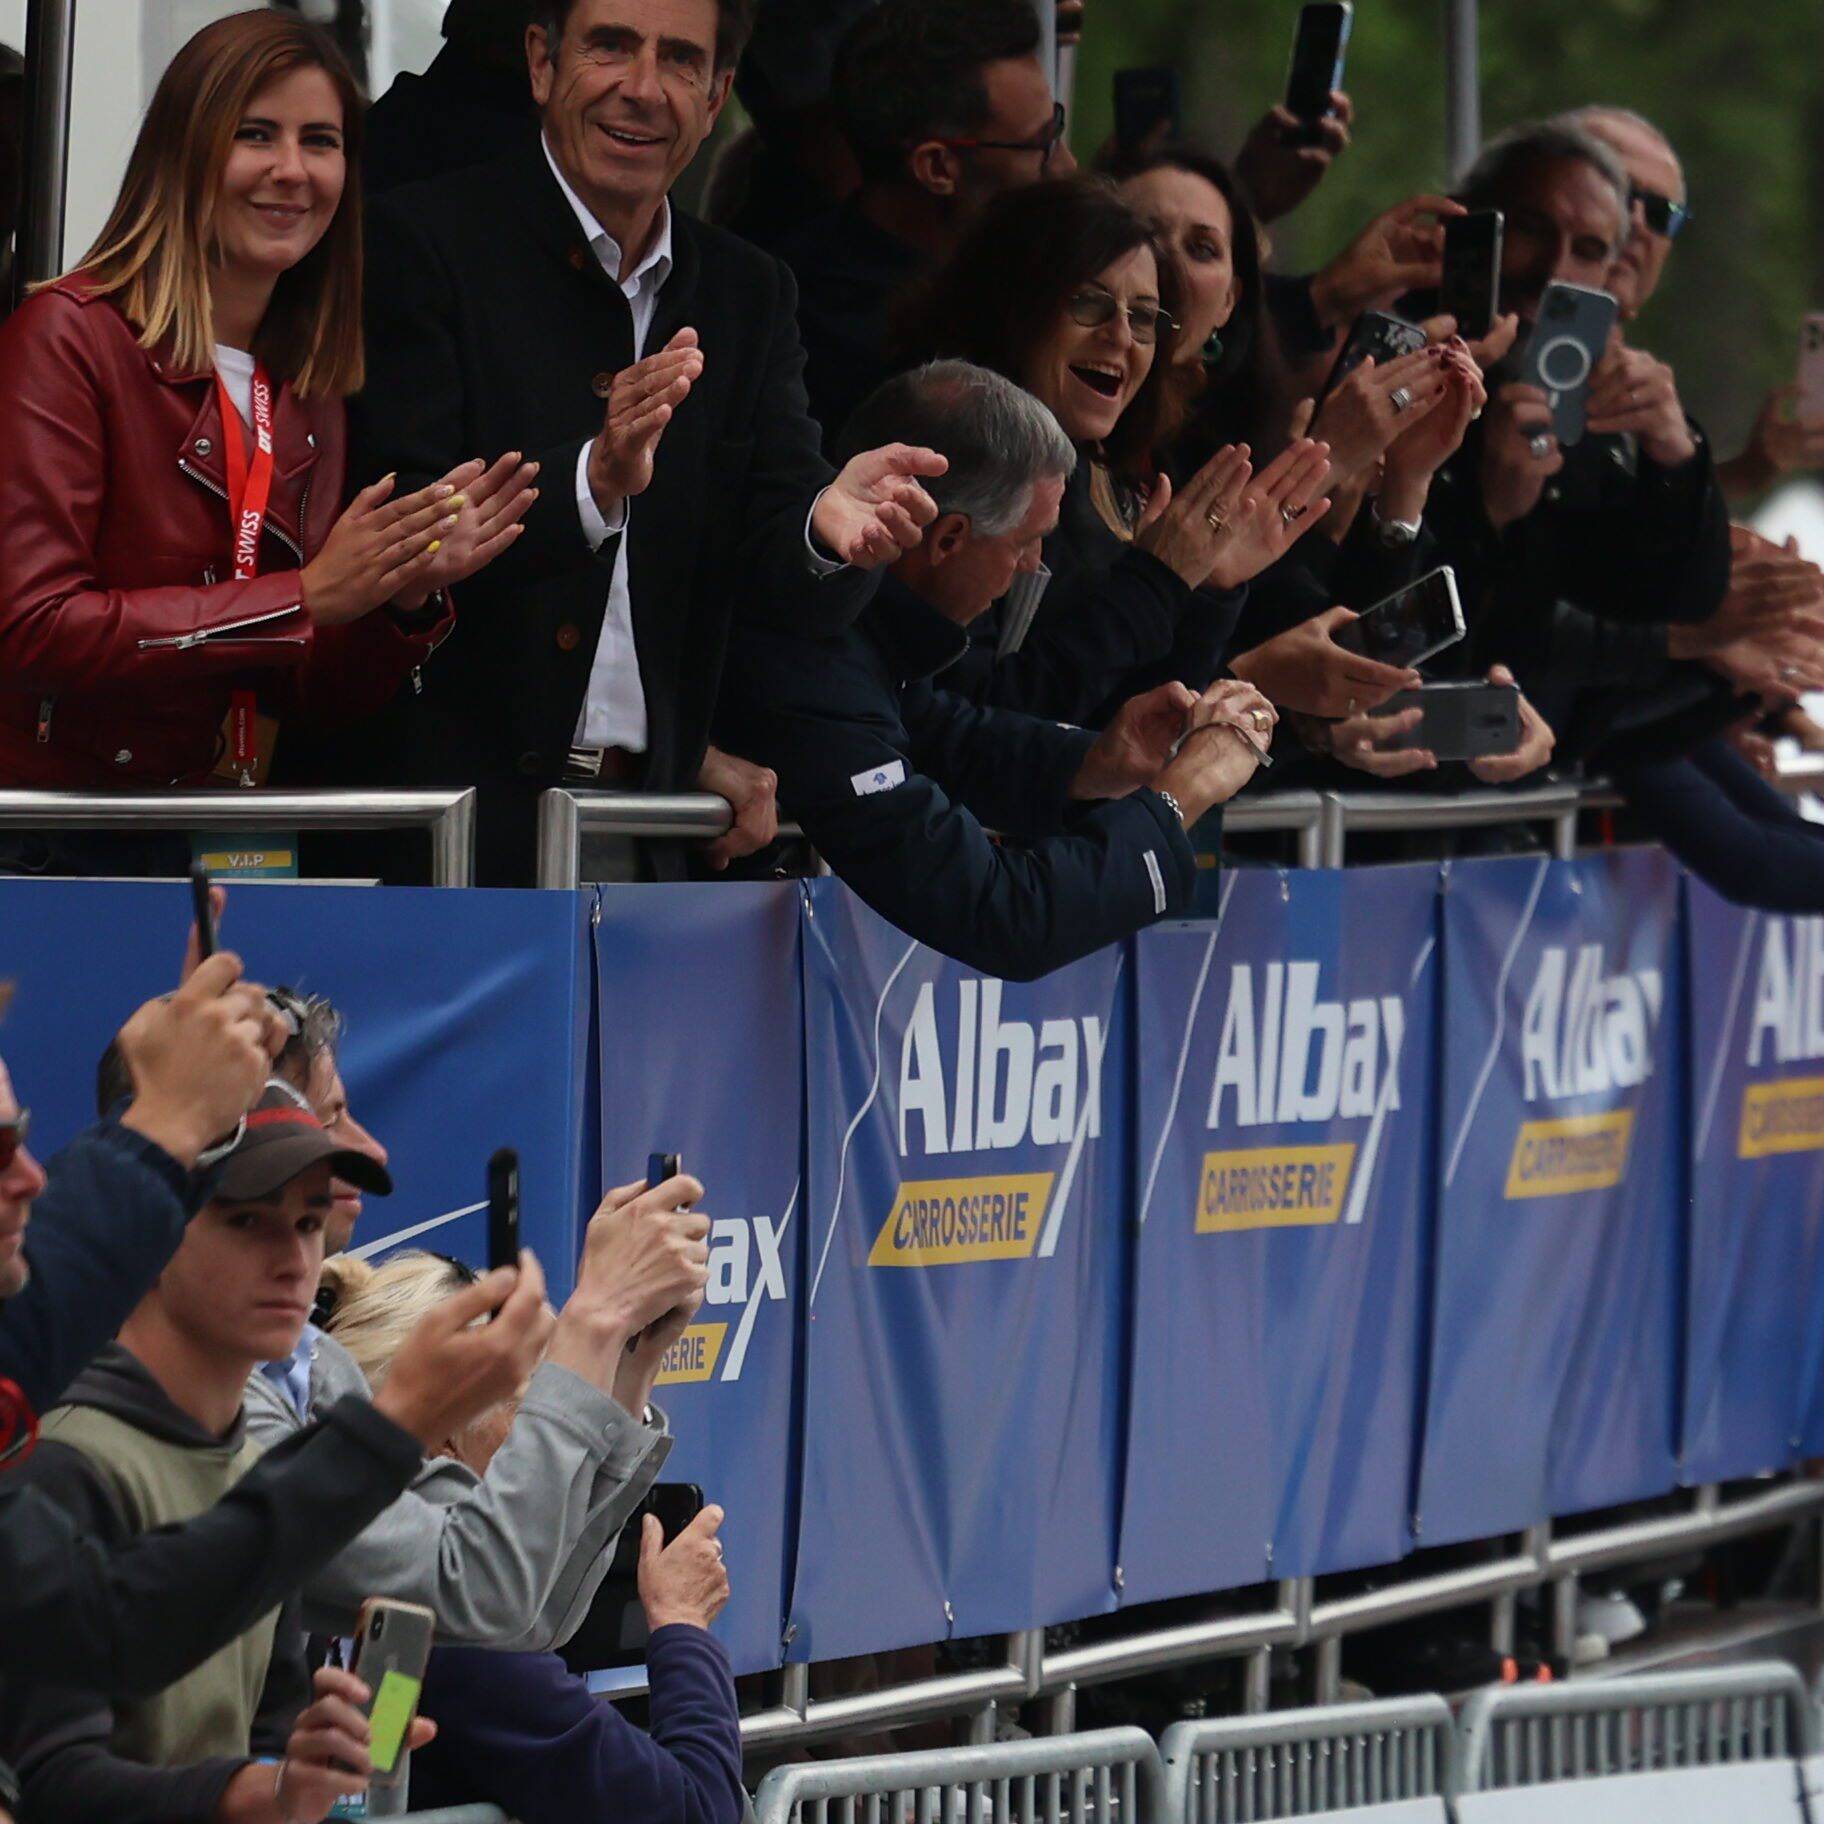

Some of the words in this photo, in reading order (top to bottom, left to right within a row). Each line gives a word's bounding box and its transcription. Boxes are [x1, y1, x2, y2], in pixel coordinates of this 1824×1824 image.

[254, 379, 271, 428] SWISS
[237, 509, 260, 566] SWISS
[1206, 961, 1404, 1129] Albax
[893, 1192, 1029, 1250] CARROSSERIE
